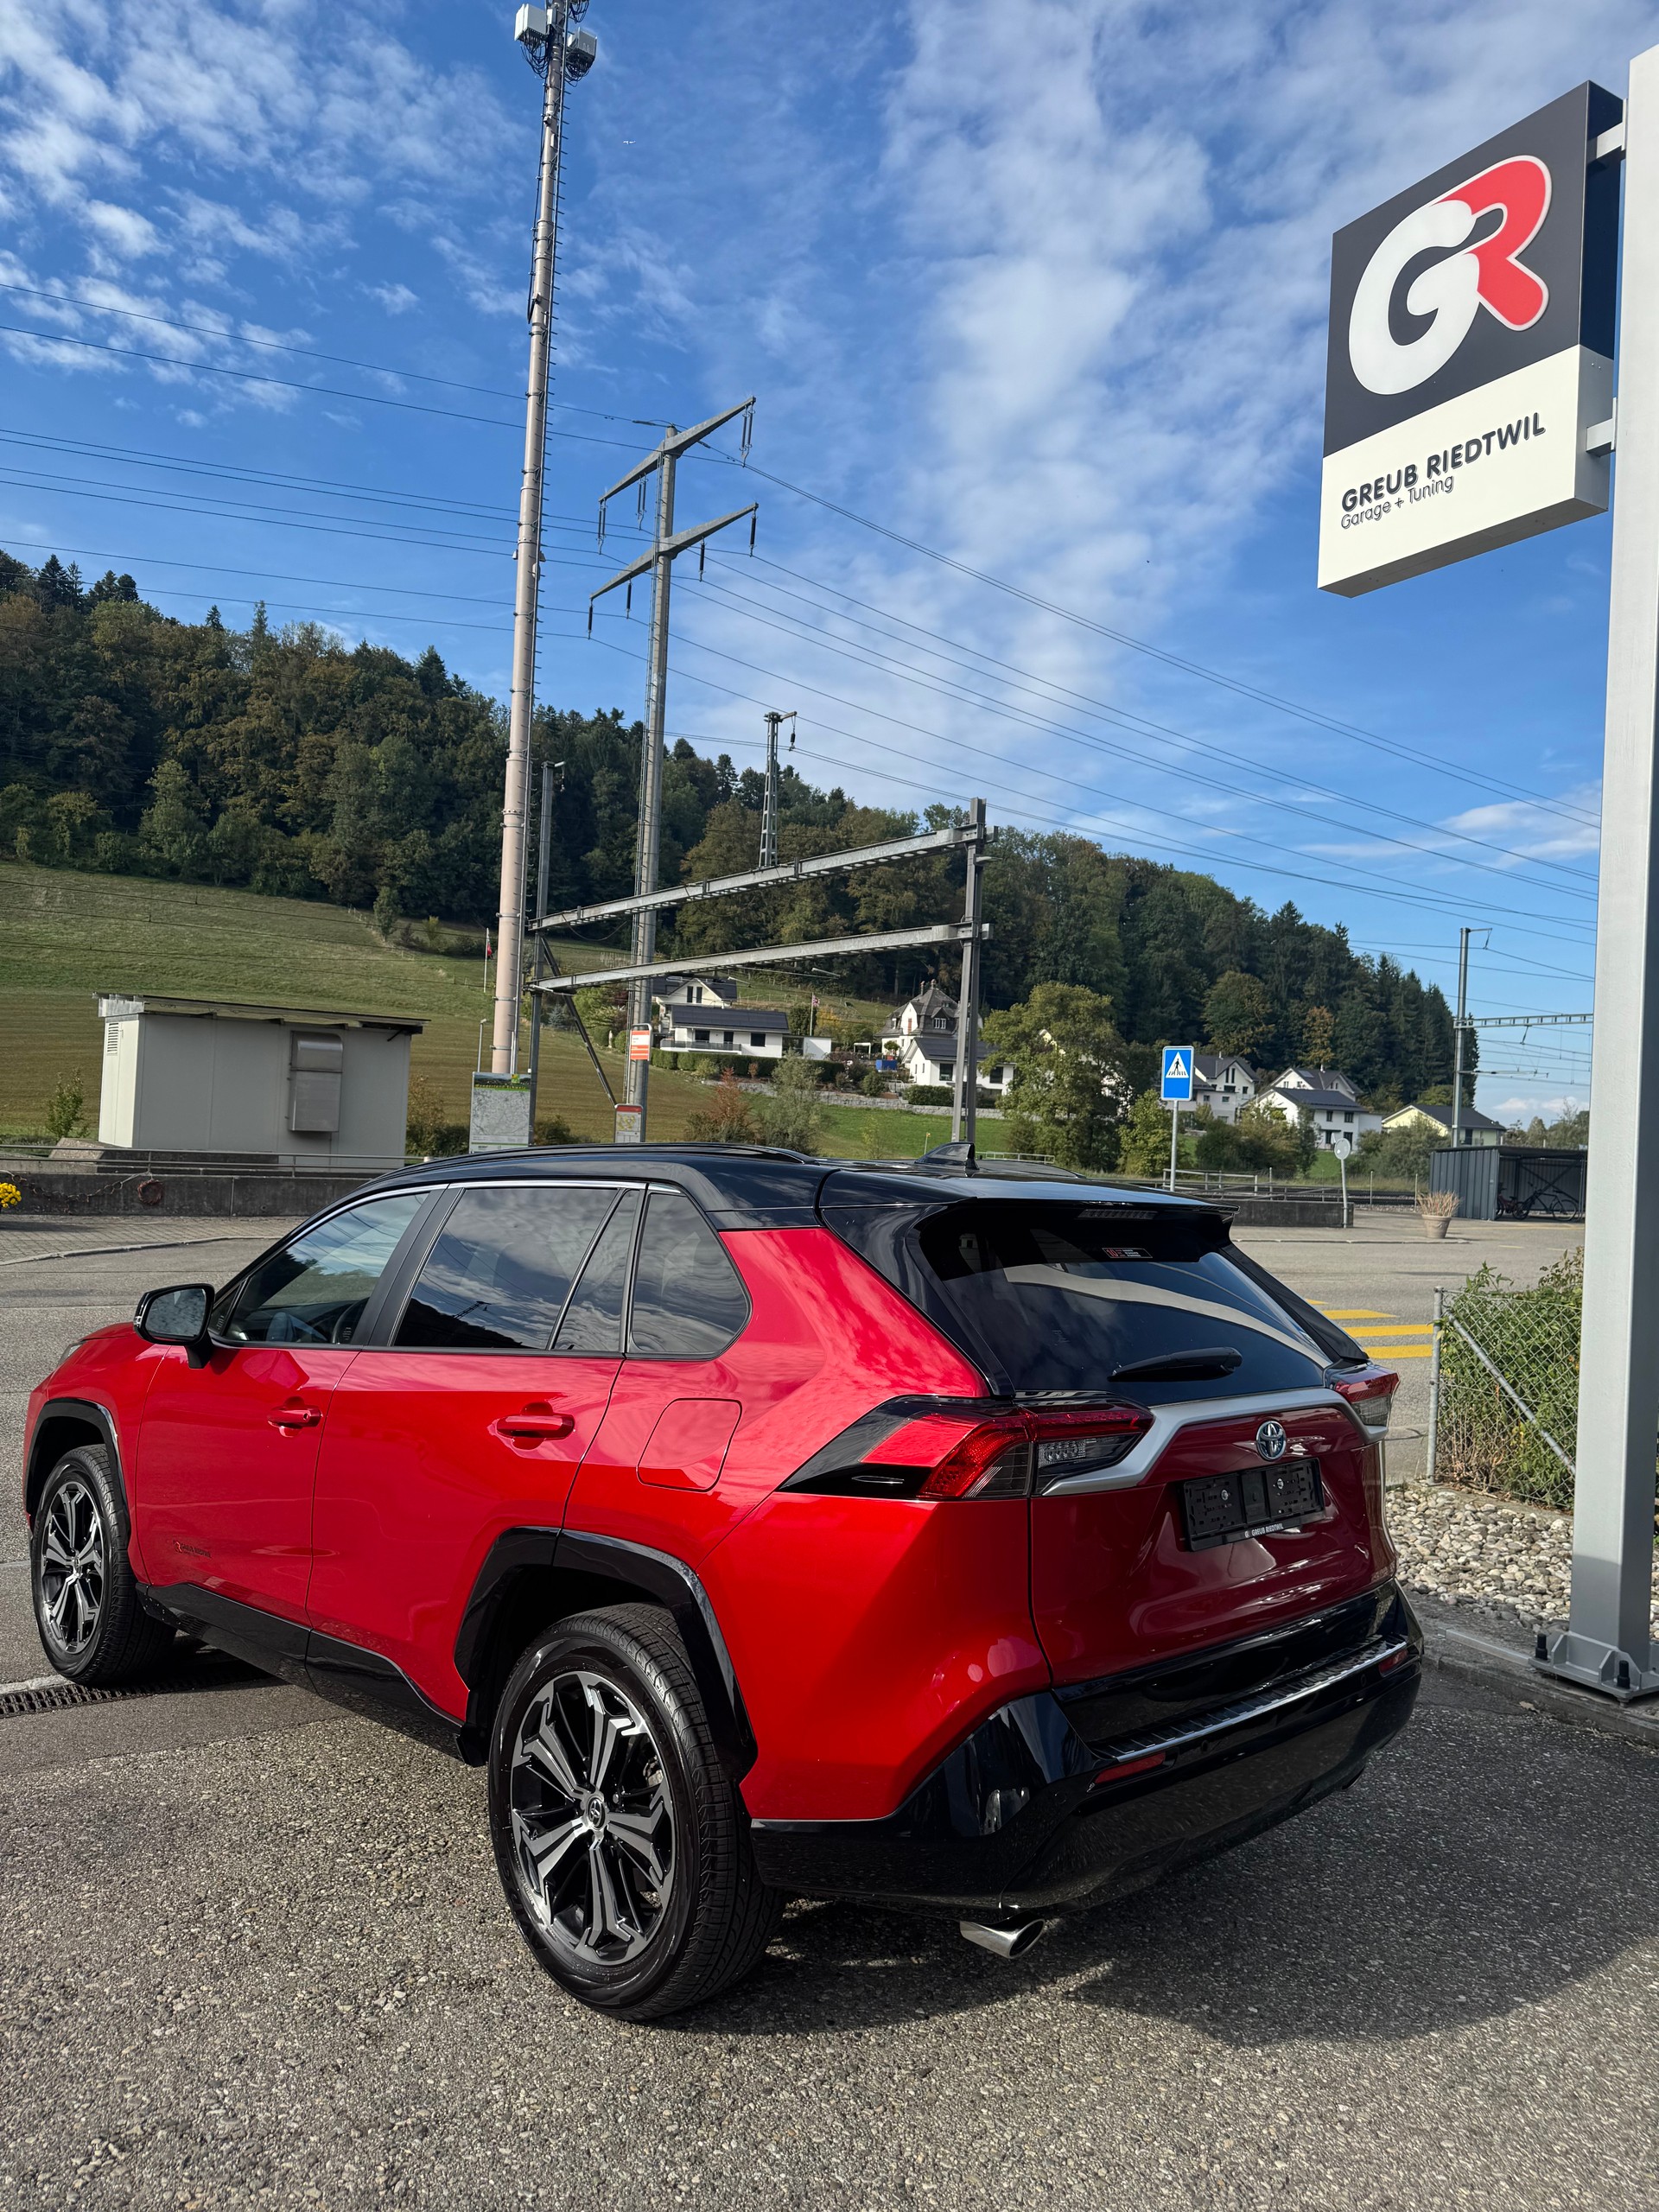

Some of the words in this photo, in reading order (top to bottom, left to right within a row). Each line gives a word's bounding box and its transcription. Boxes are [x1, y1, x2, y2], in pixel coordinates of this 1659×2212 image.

[1349, 155, 1552, 395] GR
[1341, 501, 1391, 530] Garage
[1395, 498, 1405, 508] +
[1408, 476, 1454, 504] Tuning
[1342, 464, 1418, 512] GREUB
[1427, 412, 1546, 480] RIEDTWIL
